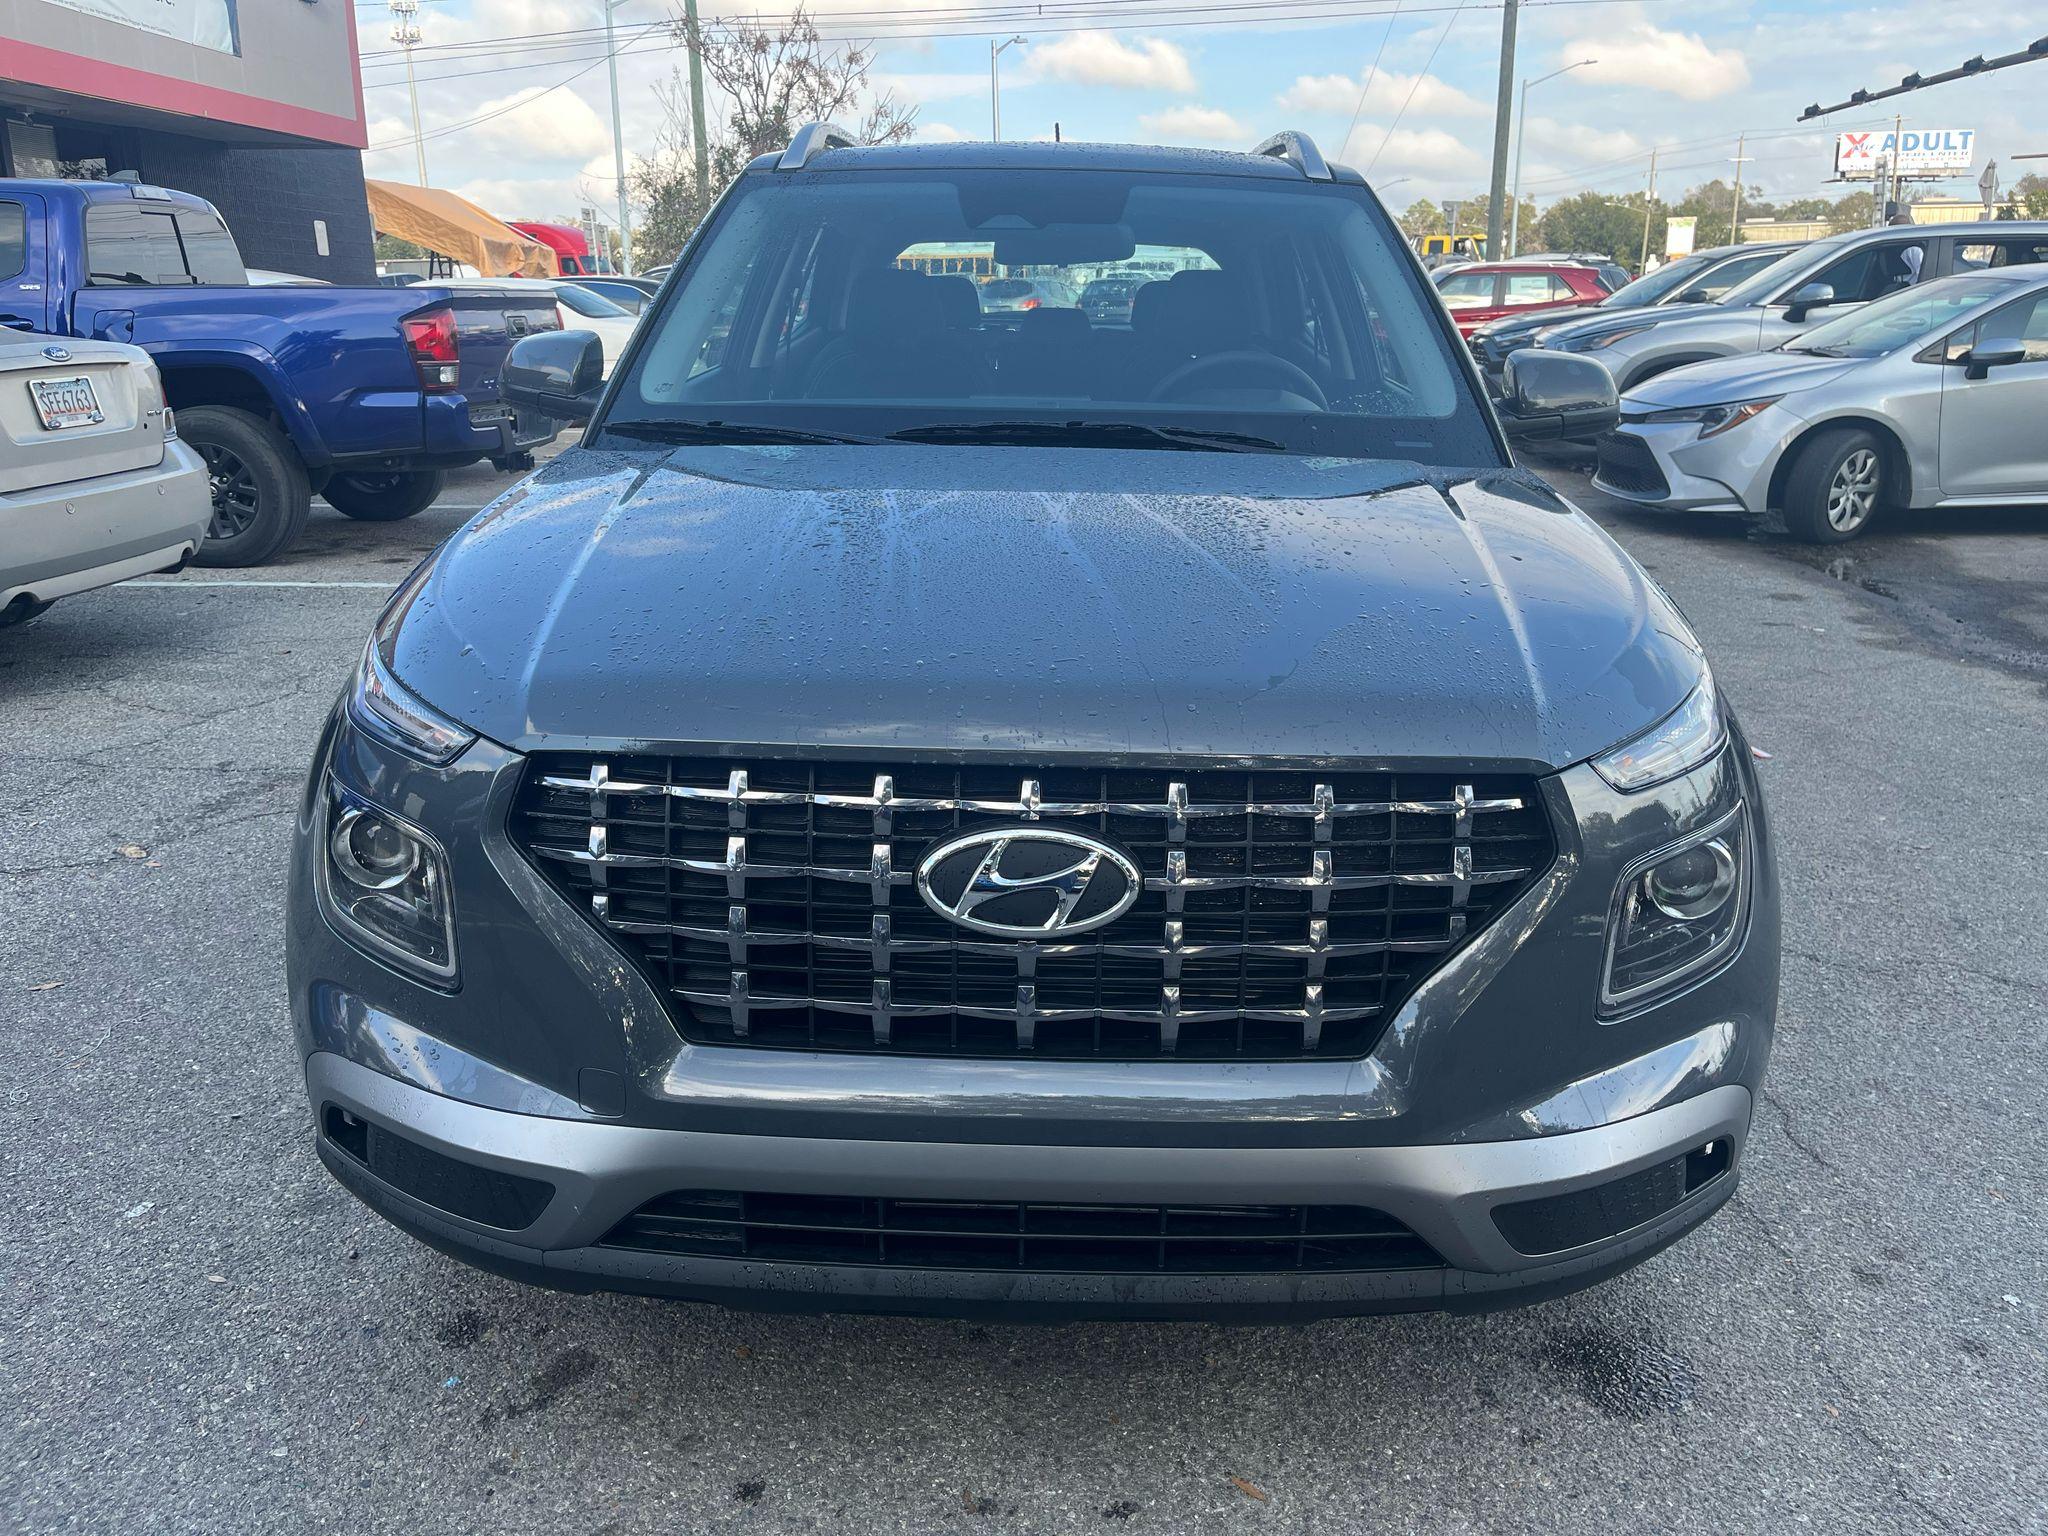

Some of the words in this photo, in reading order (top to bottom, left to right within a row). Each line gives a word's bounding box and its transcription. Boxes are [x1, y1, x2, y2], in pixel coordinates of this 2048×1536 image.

[1881, 132, 1972, 152] ADULT
[50, 347, 67, 358] Ford
[39, 389, 92, 415] SEE6763
